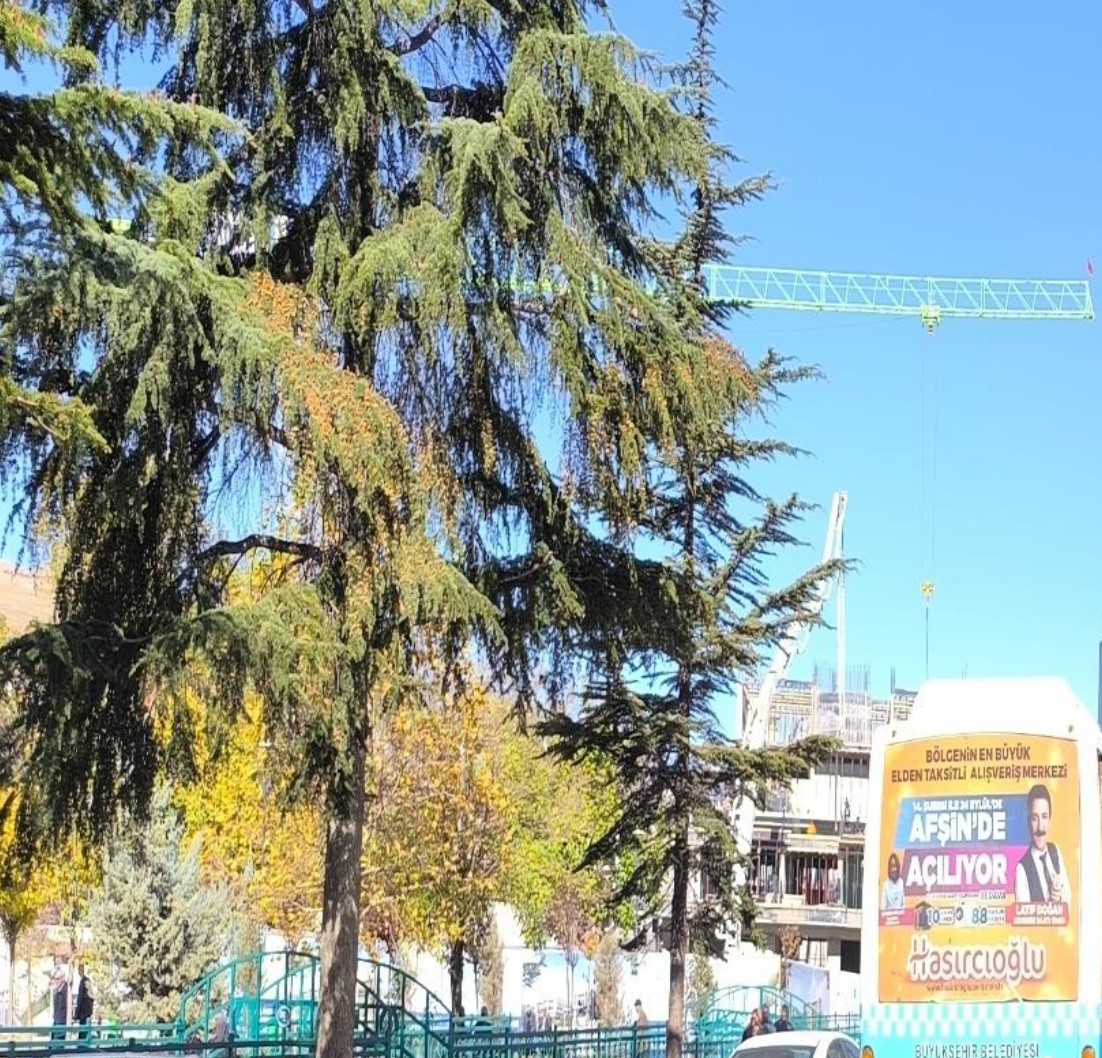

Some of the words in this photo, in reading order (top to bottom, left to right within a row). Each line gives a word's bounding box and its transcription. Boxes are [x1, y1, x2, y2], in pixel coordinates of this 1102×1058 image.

[925, 745, 978, 764] BÖLGENİN
[979, 748, 994, 762] EN
[995, 742, 1031, 761] BÜYÜK
[891, 769, 923, 784] ELDEN
[924, 767, 967, 782] TAKSİTLİ
[970, 765, 1022, 783] ALIŞVERİŞ
[1022, 763, 1068, 779] MERKEZİ
[909, 811, 1006, 846] AFŞİN'DE
[905, 853, 1008, 891] AÇILIYOR
